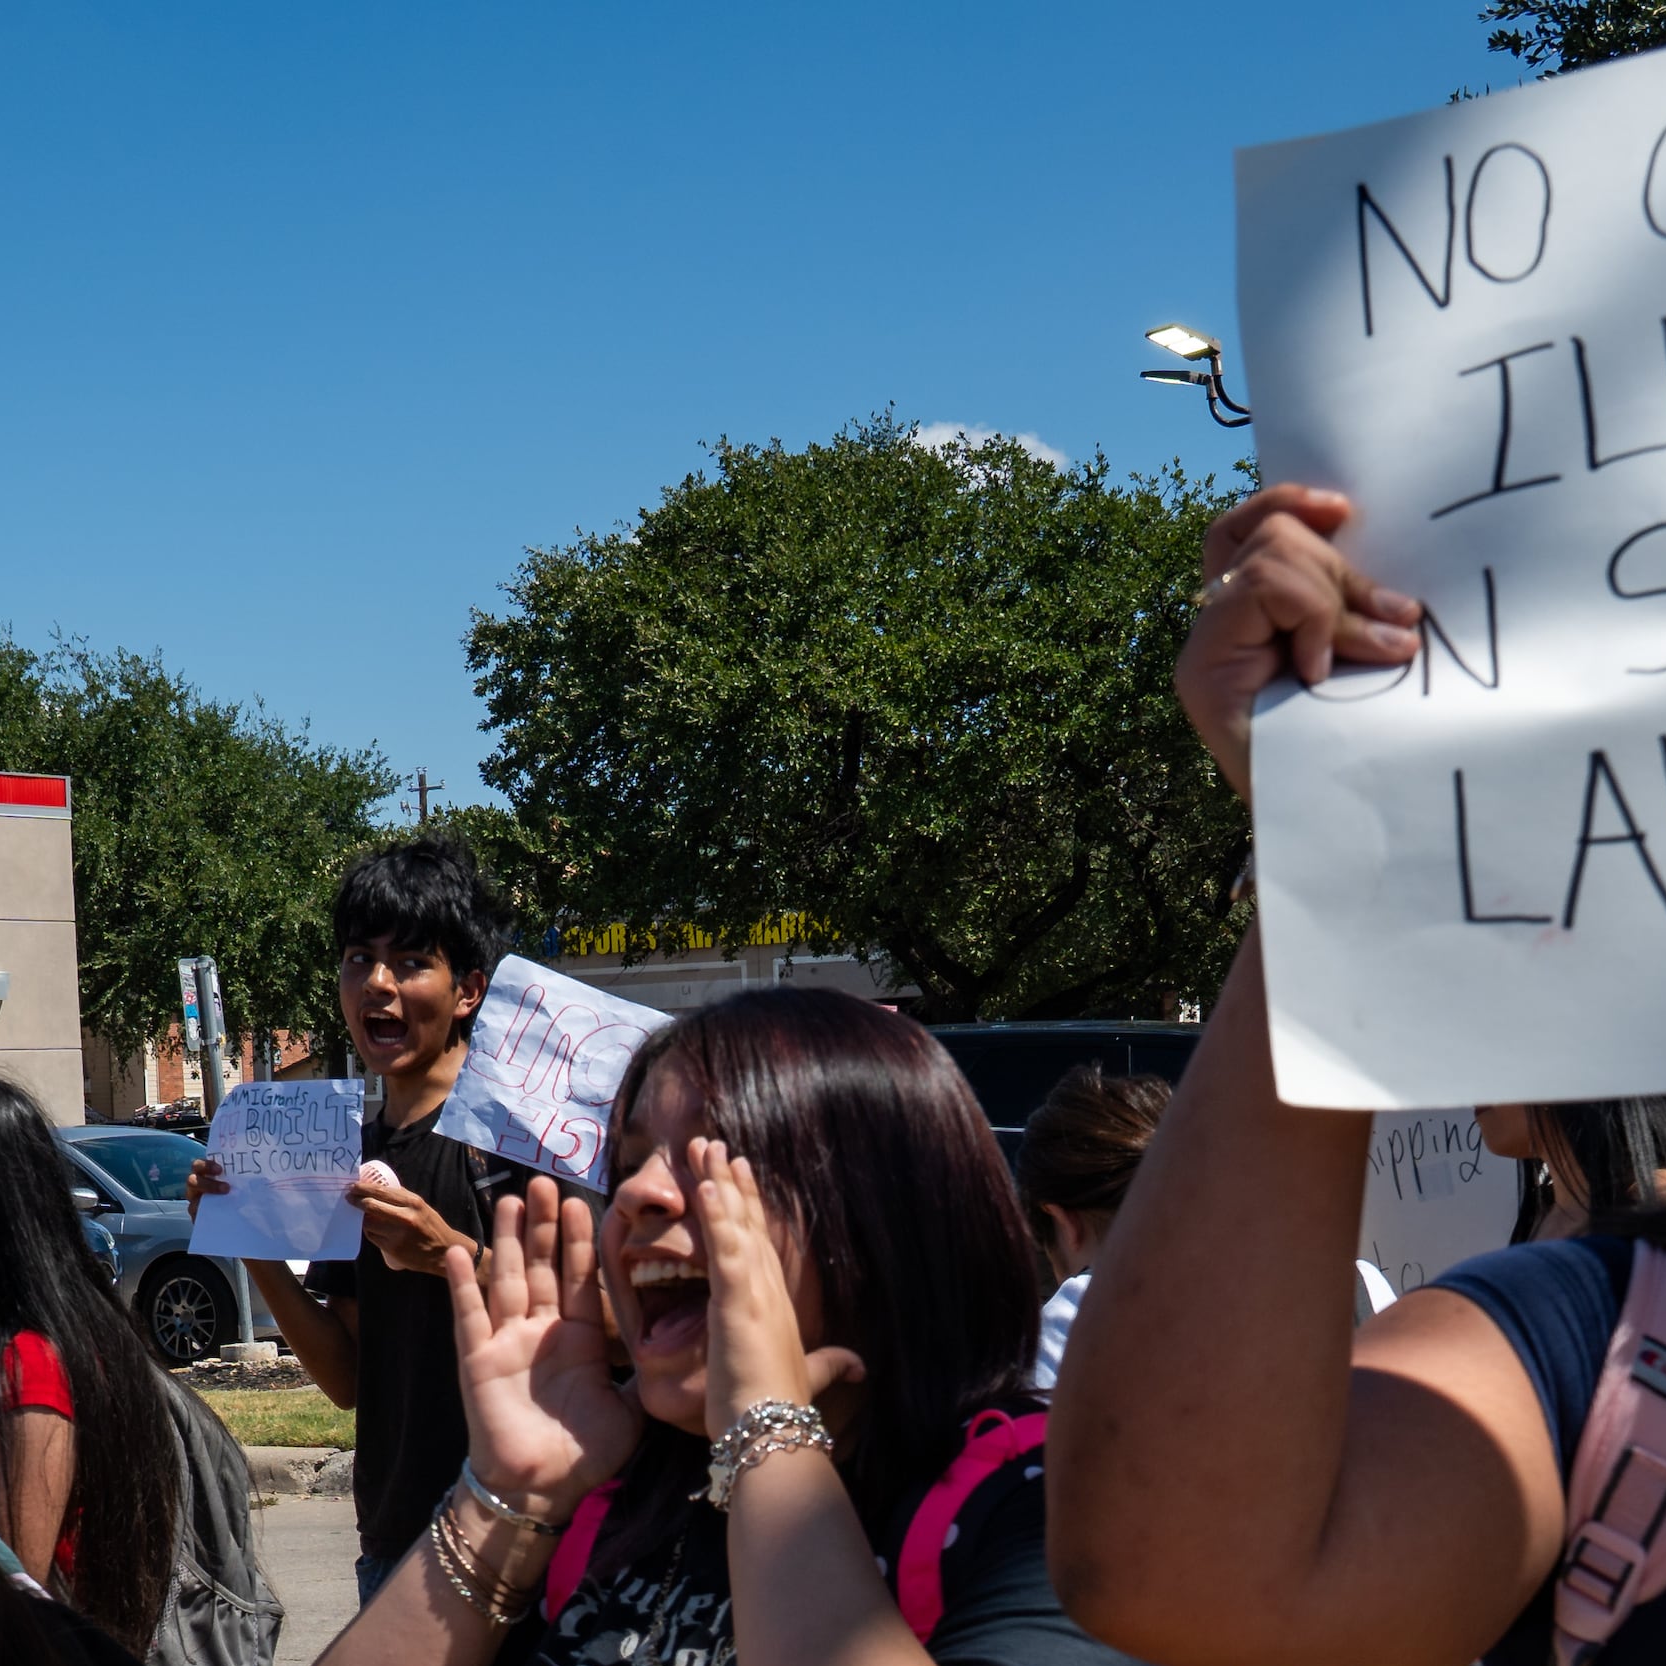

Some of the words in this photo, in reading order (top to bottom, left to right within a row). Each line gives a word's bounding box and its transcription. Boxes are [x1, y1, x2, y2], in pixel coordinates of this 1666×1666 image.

[1355, 140, 1554, 338] NO
[563, 921, 657, 956] SPORS
[245, 1092, 361, 1147] BUILT
[496, 1096, 608, 1187] CE
[208, 1150, 263, 1176] THIS
[268, 1146, 363, 1175] COUNTRY
[1366, 1117, 1483, 1201] ipping
